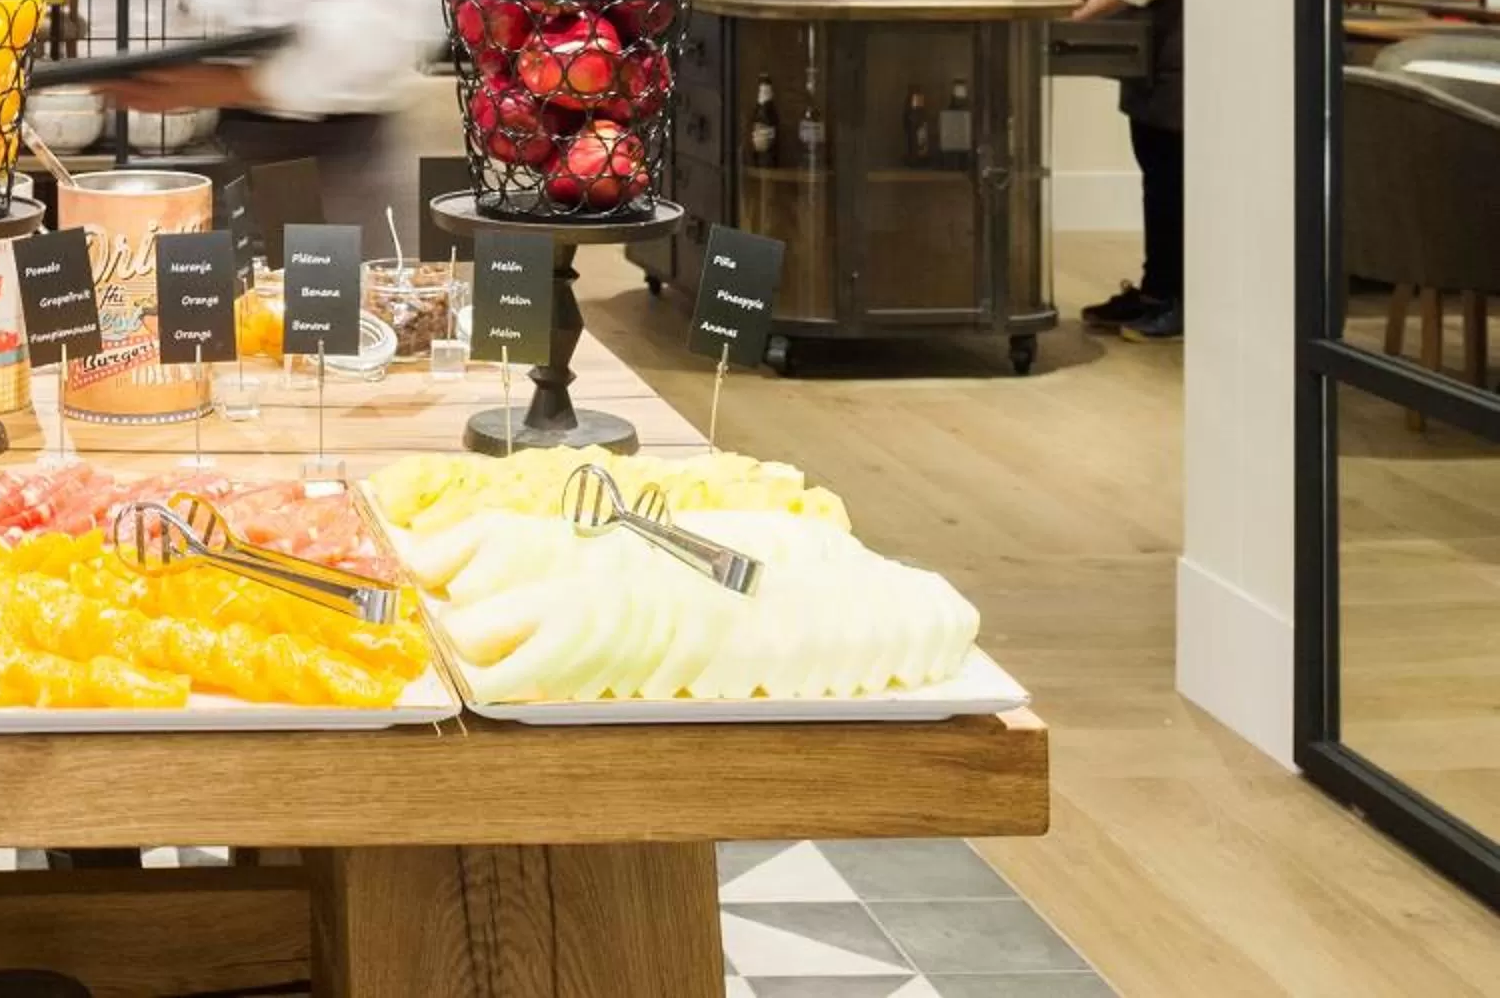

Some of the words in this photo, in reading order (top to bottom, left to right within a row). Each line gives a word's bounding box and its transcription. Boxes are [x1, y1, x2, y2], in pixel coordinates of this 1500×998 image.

[171, 262, 212, 274] Naranja
[181, 295, 219, 307] Orange
[500, 294, 531, 306] Melon
